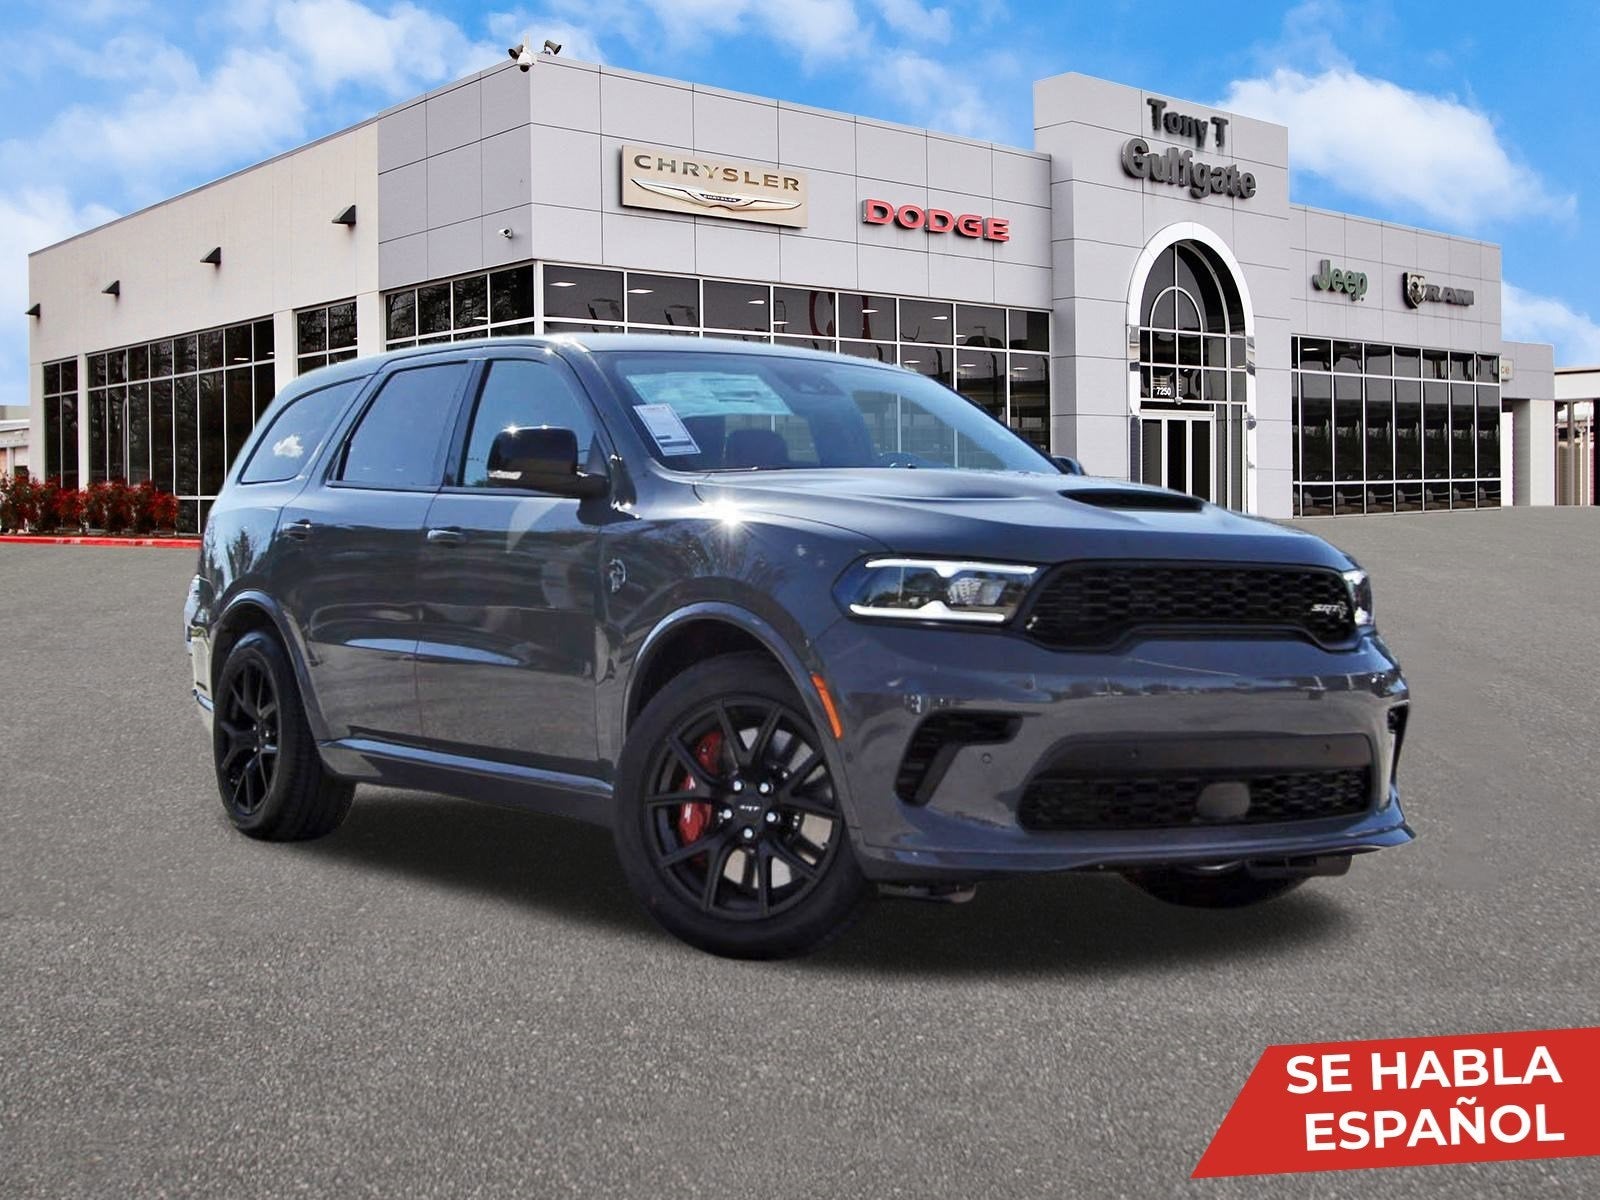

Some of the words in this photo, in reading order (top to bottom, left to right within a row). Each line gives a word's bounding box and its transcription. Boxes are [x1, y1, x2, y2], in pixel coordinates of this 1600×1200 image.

[1147, 98, 1208, 147] Tony
[1210, 117, 1229, 147] T
[633, 154, 800, 192] CHRYSLER
[1121, 138, 1257, 199] Gulfgate
[862, 198, 1010, 242] DODGE
[1312, 259, 1368, 301] Jeep
[1424, 284, 1475, 306] RAM
[1156, 386, 1172, 396] 7250
[1311, 603, 1340, 615] SRT
